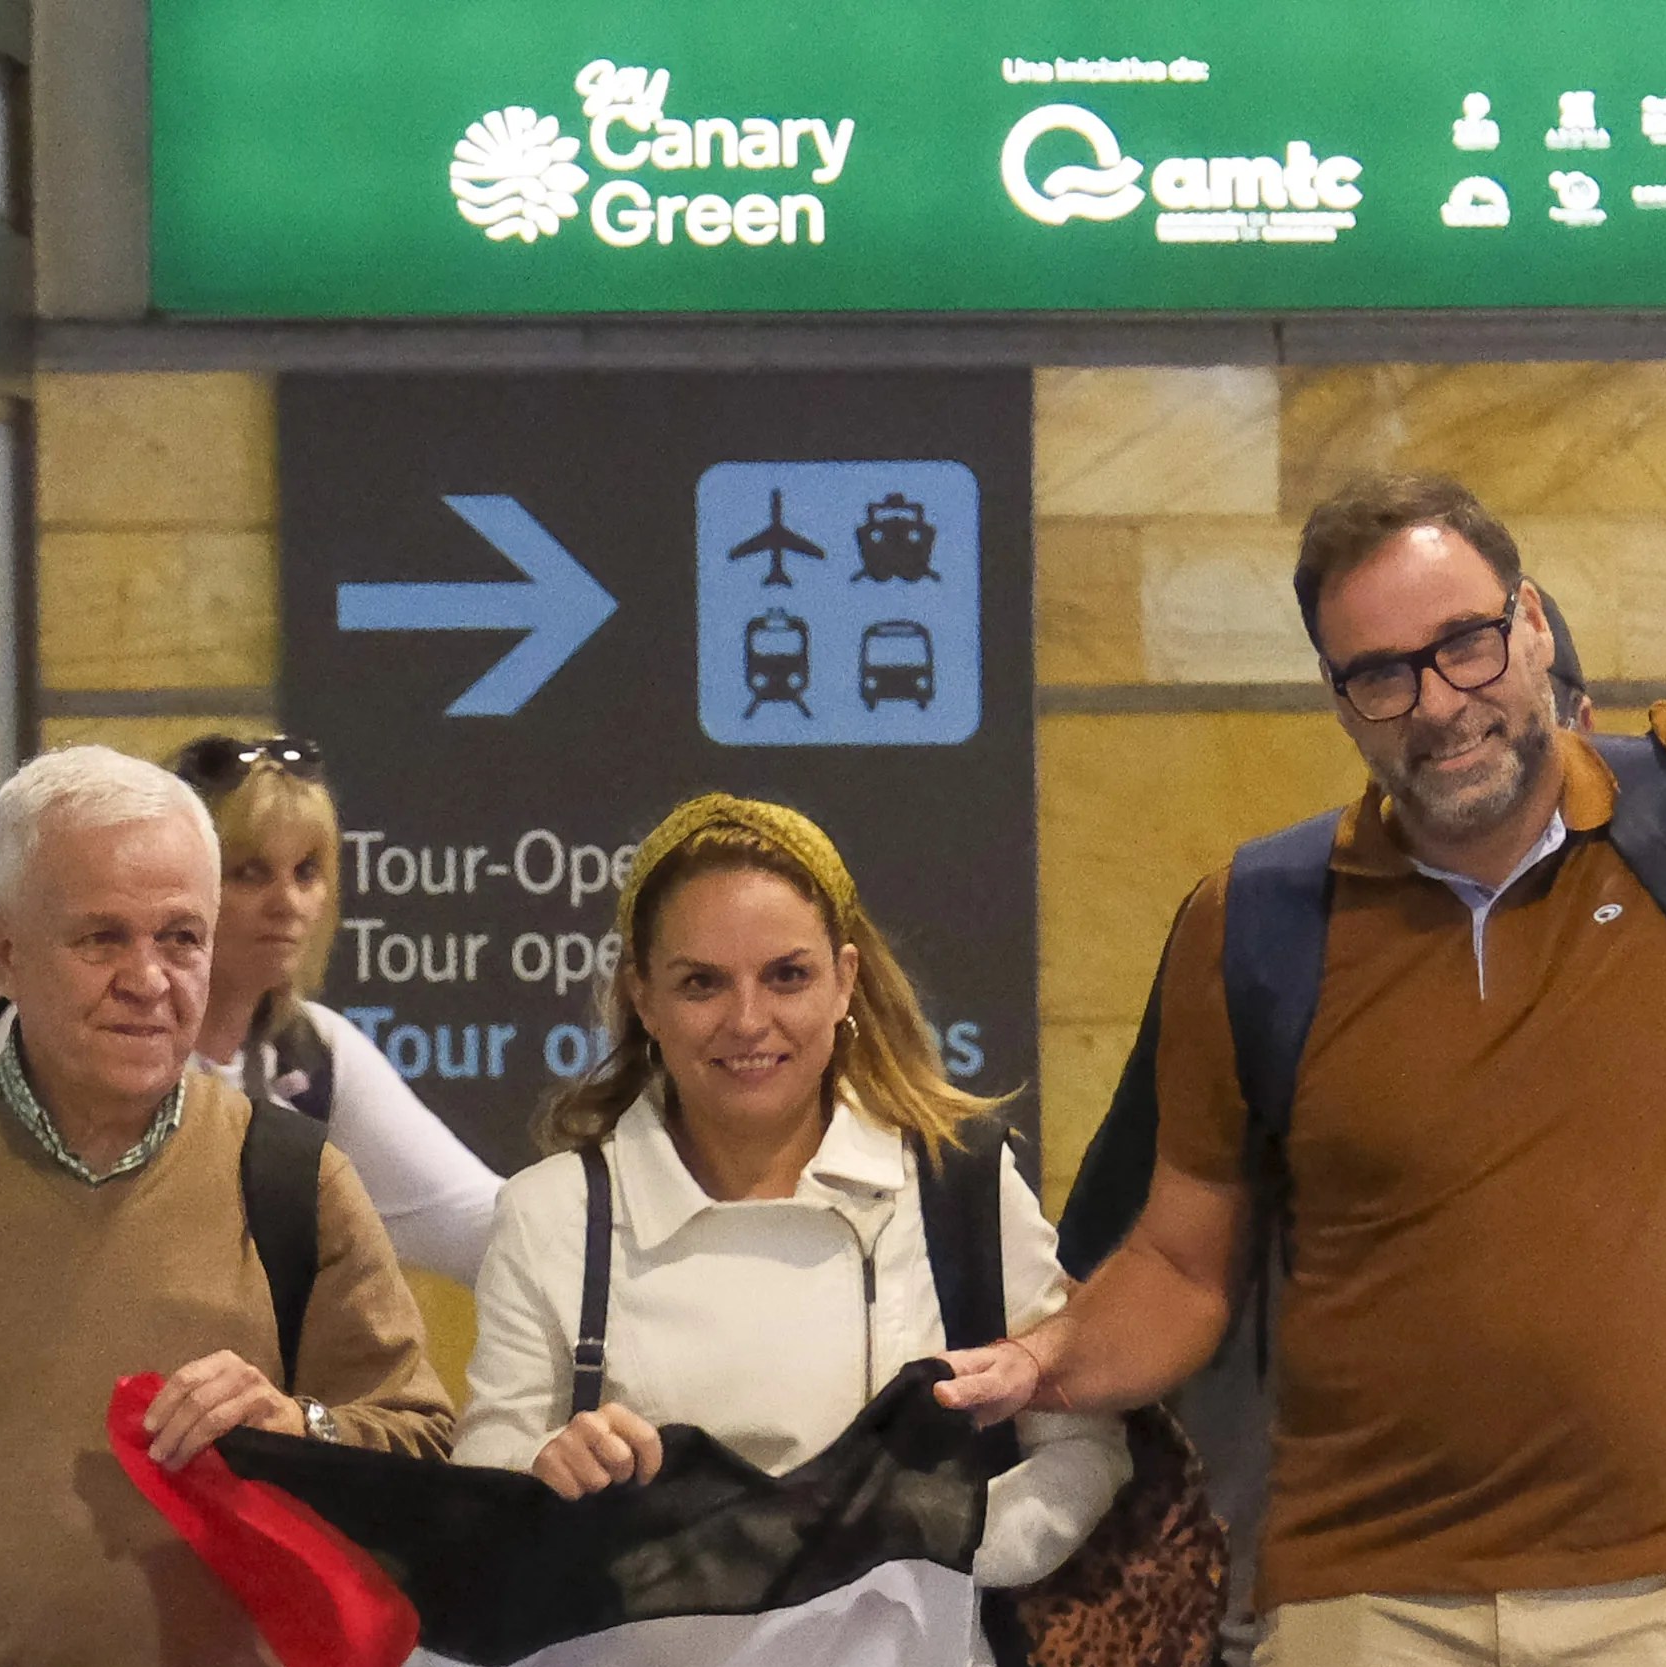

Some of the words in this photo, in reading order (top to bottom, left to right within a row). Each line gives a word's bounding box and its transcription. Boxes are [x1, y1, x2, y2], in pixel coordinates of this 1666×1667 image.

[589, 110, 855, 184] Canary
[1151, 140, 1364, 210] amtc
[589, 179, 826, 248] Green
[342, 828, 644, 908] Tour-Ope
[342, 917, 489, 983] Tour
[342, 1005, 518, 1080] Tour
